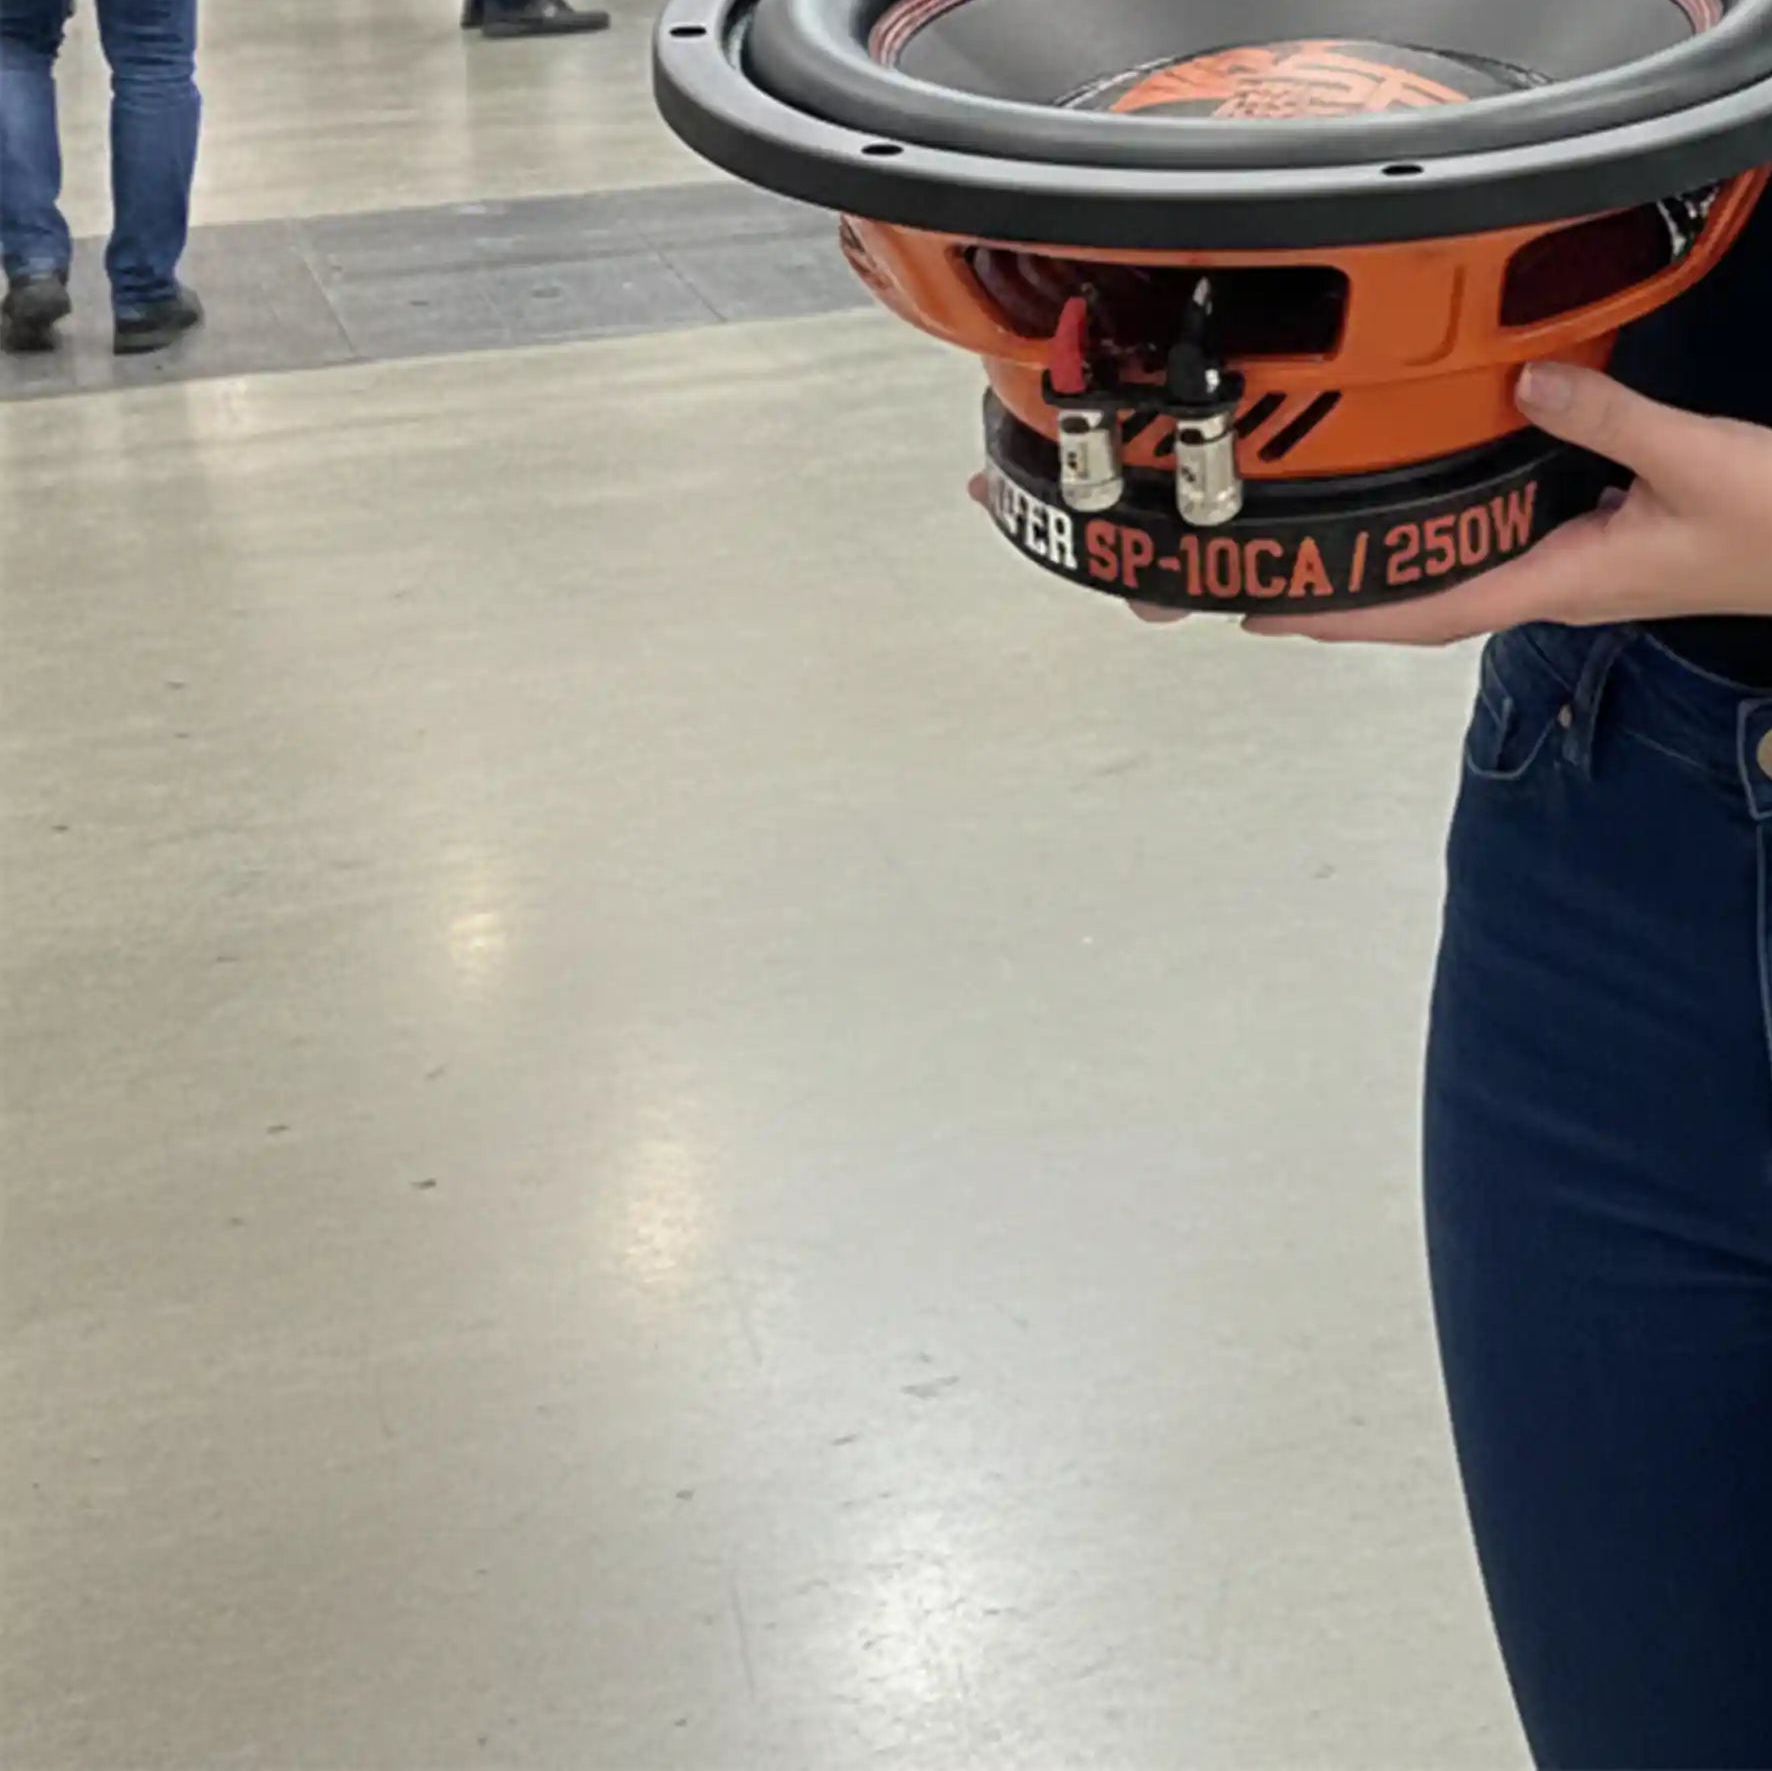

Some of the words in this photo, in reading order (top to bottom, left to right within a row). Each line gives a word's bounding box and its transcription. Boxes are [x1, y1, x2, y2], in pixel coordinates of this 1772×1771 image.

[1085, 519, 1334, 598] SP-10CA
[1347, 532, 1370, 593] /
[1384, 481, 1538, 586] 250W
